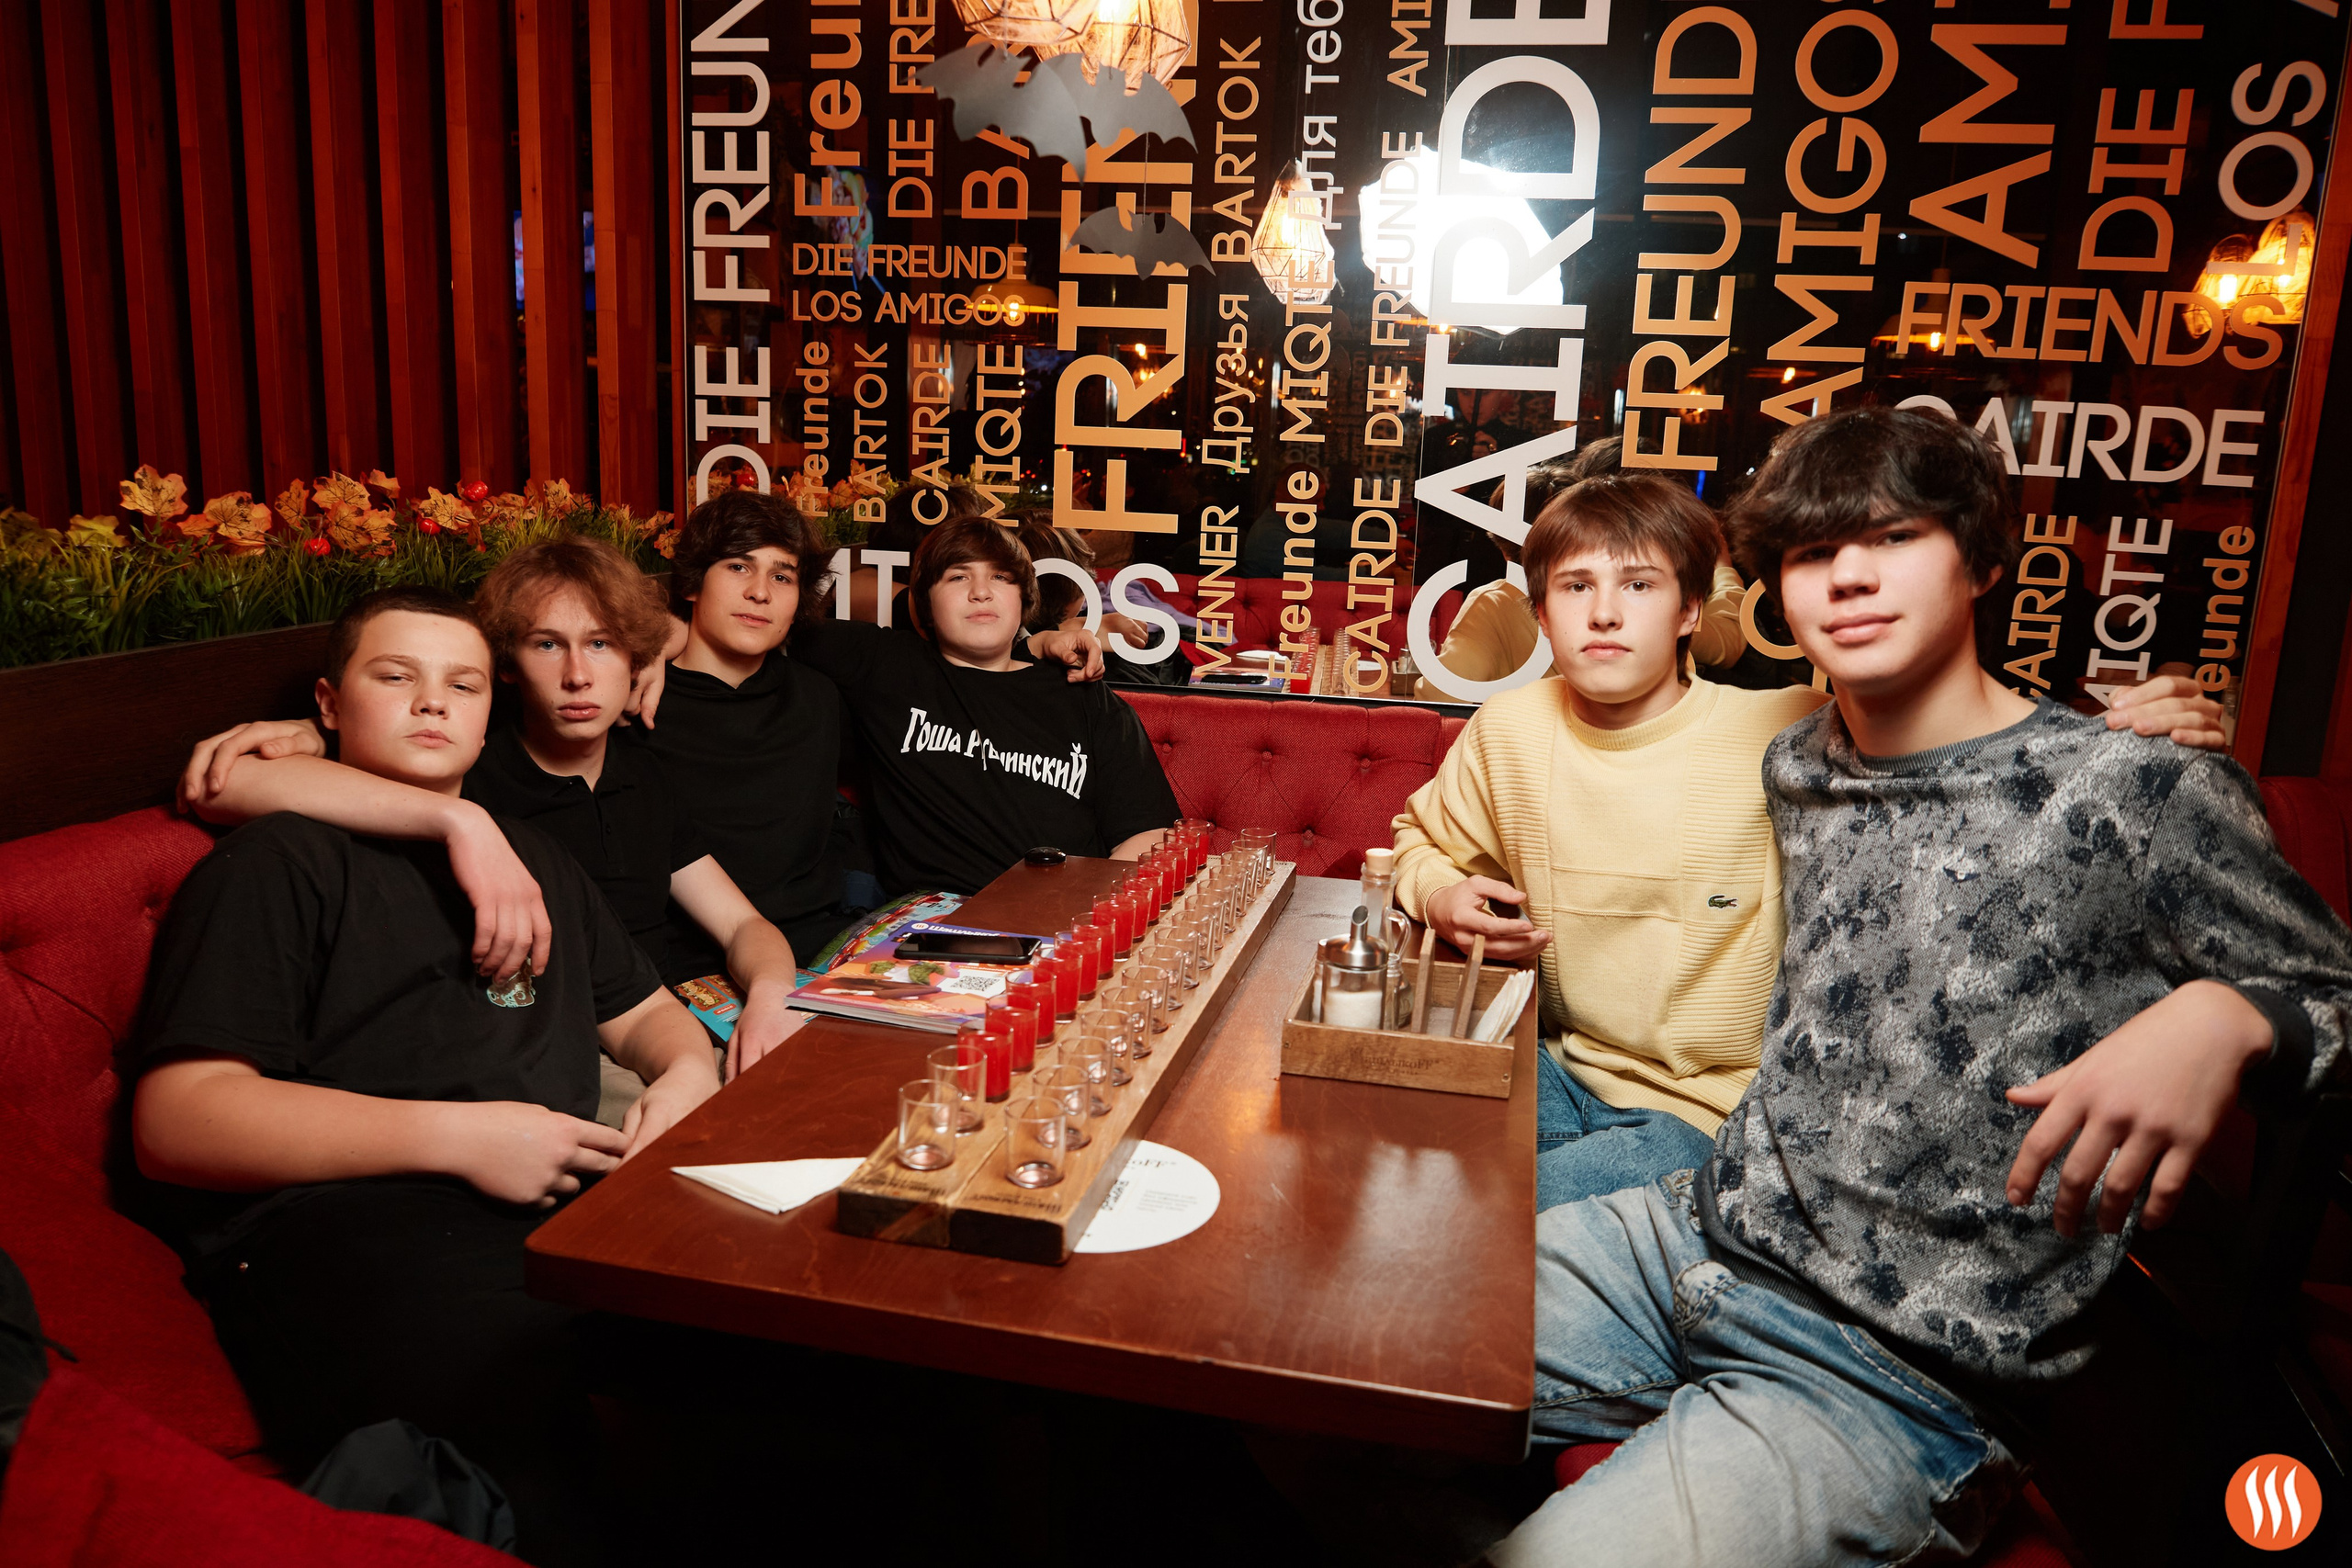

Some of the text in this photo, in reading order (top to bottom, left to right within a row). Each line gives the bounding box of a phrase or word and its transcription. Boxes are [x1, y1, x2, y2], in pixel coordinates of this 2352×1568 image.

[794, 0, 863, 216] Freu
[888, 0, 935, 218] DIE FRE
[1211, 36, 1262, 263] BARTOK
[1287, 116, 1344, 230] Для
[1908, 0, 2071, 269] AM
[2077, 88, 2195, 272] DIE
[2206, 61, 2327, 276] LOS
[792, 243, 1027, 280] DIE FREUNDE
[1053, 0, 1200, 534] FRIEN
[1370, 131, 1423, 346] FREUNDE
[1622, 6, 1758, 471] FREUND
[1760, 0, 1899, 426] AMIGO
[792, 289, 1026, 326] LOS AMIGOS
[1201, 293, 1256, 474] Друзья
[1895, 281, 2286, 370] FRIENDS
[695, 345, 771, 507] DIE
[796, 341, 830, 517] Freunde
[854, 343, 888, 523] BARTOK
[910, 344, 951, 525] CAIRDE
[975, 344, 1023, 527] MIQTE
[1268, 260, 1335, 681] Freunde MIQTE
[1364, 365, 1408, 446] DIE
[1894, 395, 2266, 488] AIRDE
[1195, 505, 1239, 676] VENNER
[1342, 478, 1401, 693] CAIRDE
[2003, 513, 2078, 698] AIRDE
[2195, 525, 2256, 693] eunde
[900, 706, 961, 753] Гоша
